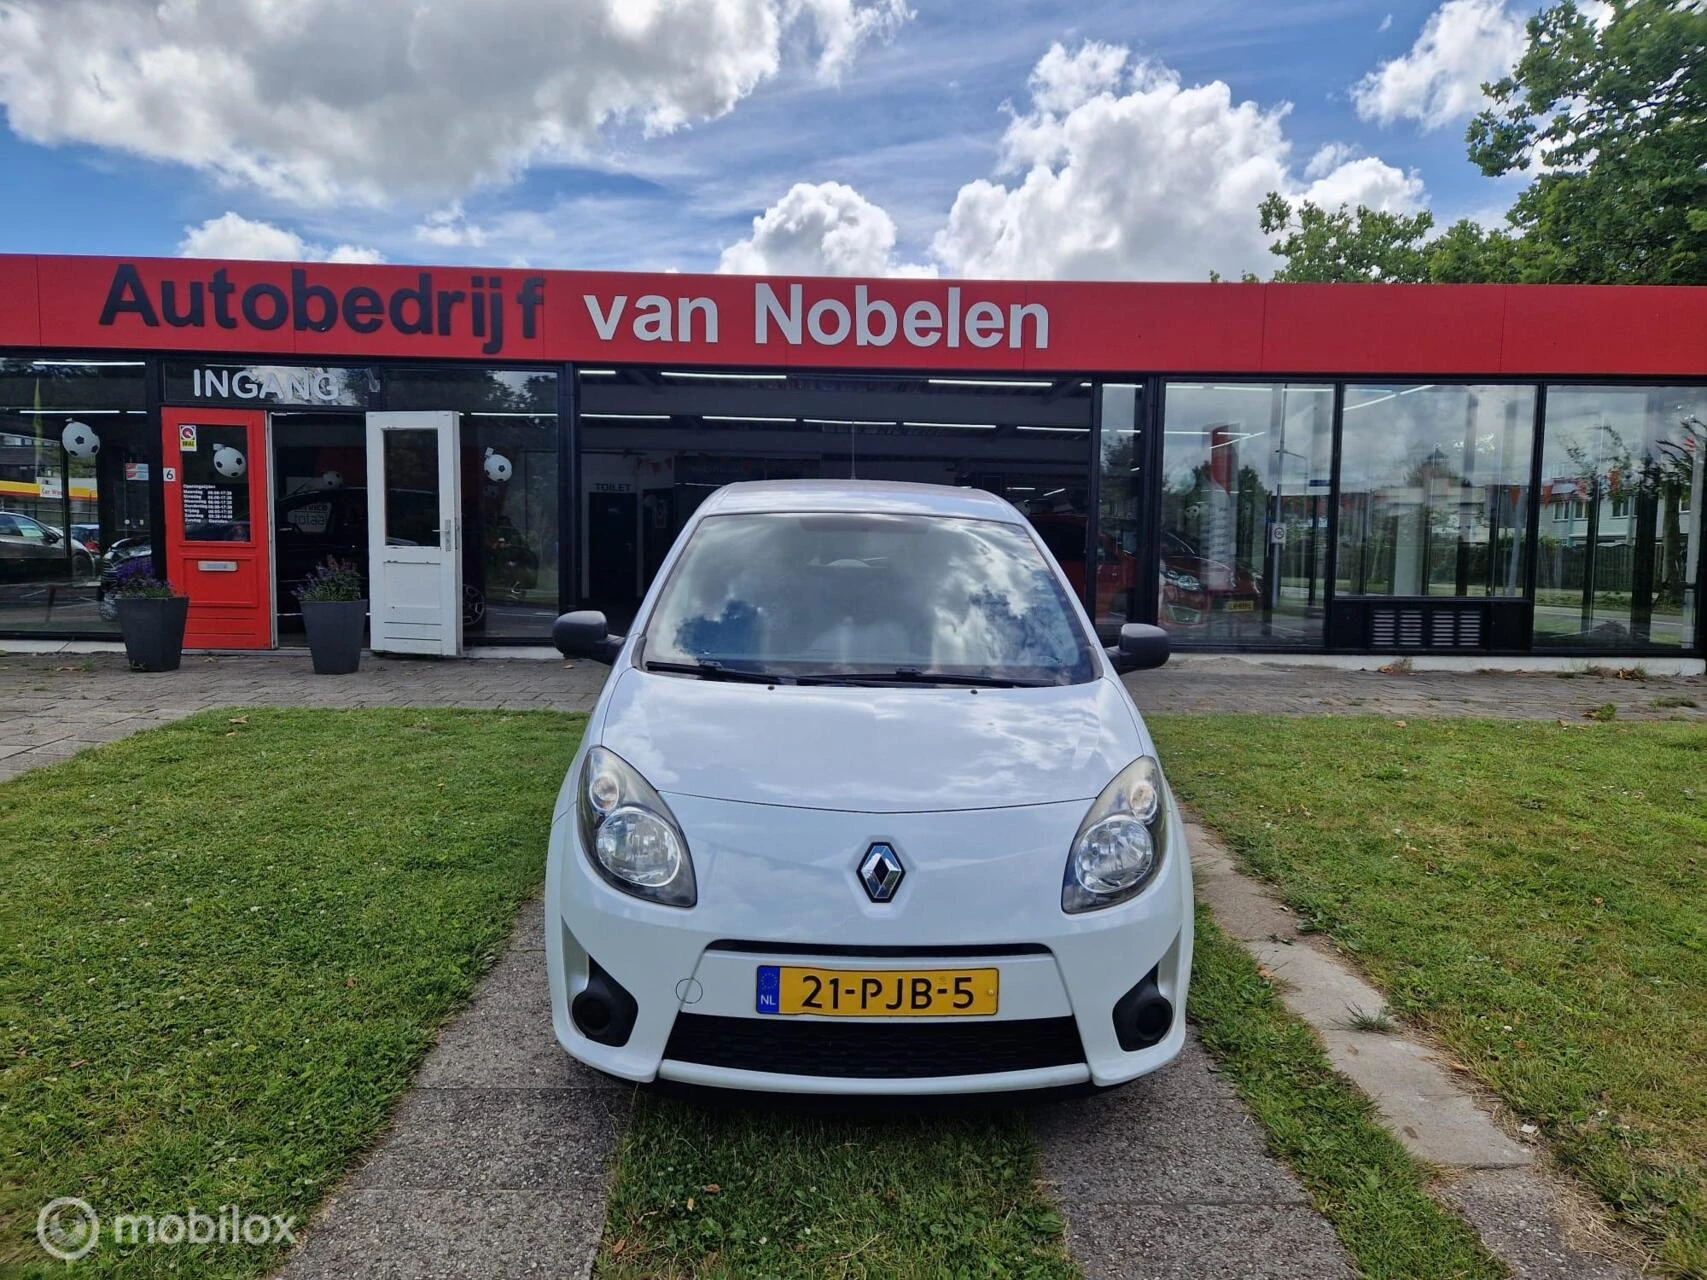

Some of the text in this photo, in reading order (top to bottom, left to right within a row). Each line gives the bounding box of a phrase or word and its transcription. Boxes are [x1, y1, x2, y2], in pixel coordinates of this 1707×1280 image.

[99, 263, 1048, 354] Autobedrijf van Nobelen
[193, 368, 339, 400] INGANG
[166, 469, 174, 480] 6
[760, 974, 975, 1010] NL 21-PJB-5
